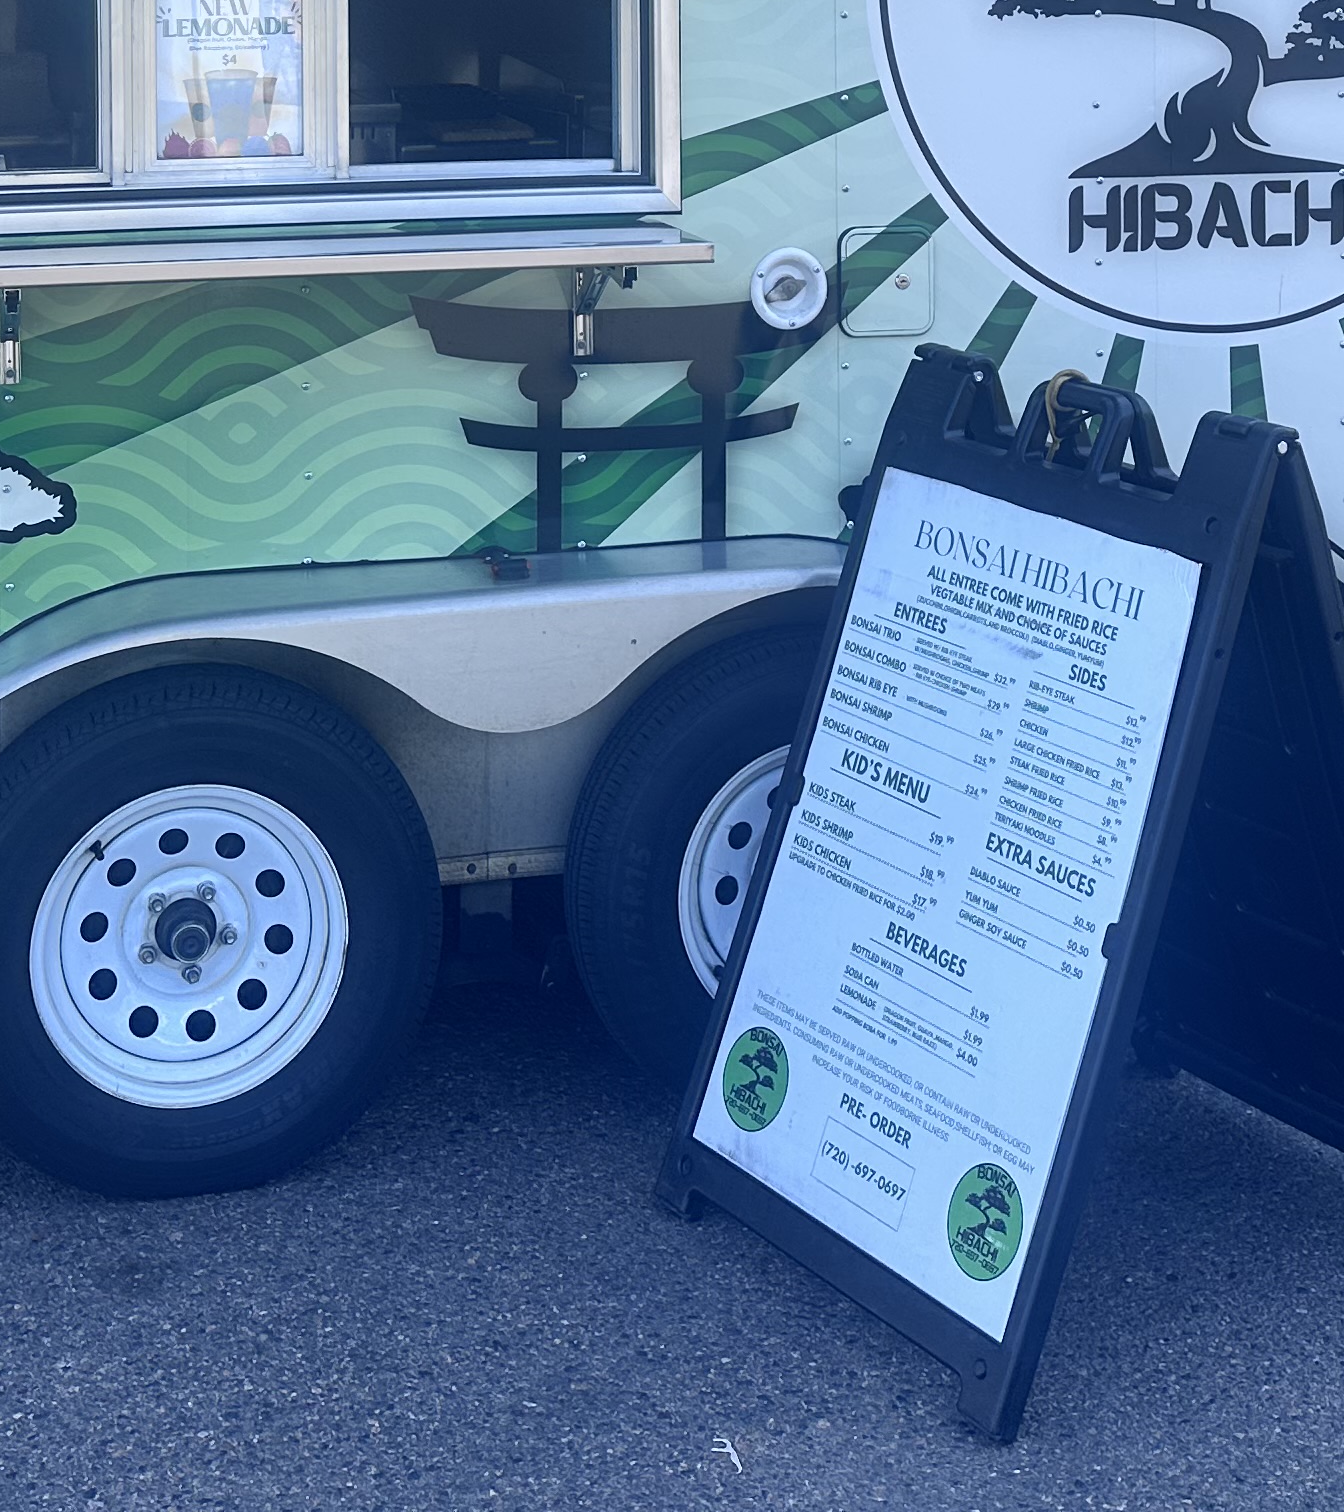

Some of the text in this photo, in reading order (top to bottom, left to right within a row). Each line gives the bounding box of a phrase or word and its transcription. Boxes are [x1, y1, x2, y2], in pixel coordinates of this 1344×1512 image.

[162, 16, 296, 38] LEMONADE
[221, 53, 237, 67] $4
[913, 517, 1146, 622] BONSAI HIBACHI
[892, 600, 949, 635] ENTREES
[926, 563, 1119, 643] ALL ENTREE COME WITH FRIED RICE
[928, 582, 1109, 657] VEGTABLE MIX AND CHOICE OF SAUCES
[849, 613, 882, 635] BONSAI
[881, 625, 903, 643] TRIO
[843, 638, 875, 660] BONSAI
[874, 651, 908, 673] COMBO
[835, 663, 869, 686] BONSAI
[867, 676, 882, 691] RIB
[881, 682, 899, 698] EYE
[1067, 662, 1108, 692] SIDES
[829, 687, 862, 710] BONSAI
[860, 700, 893, 723] SHRIMP
[1053, 688, 1076, 705] STEAK
[821, 715, 854, 738] BONSAI
[852, 728, 890, 754] CHICKEN
[1018, 717, 1049, 737] CHICKEN
[1008, 754, 1031, 771] STEAK
[1030, 763, 1050, 779] FRIED
[1049, 771, 1066, 786] RICE
[1013, 736, 1036, 753] LARGE
[1035, 745, 1066, 766] CHICKEN
[1064, 757, 1085, 773] FRIED
[1084, 765, 1101, 780] RICE
[808, 780, 830, 800] KIDS
[828, 790, 857, 813] STEAK
[881, 765, 932, 805] MENU
[1028, 785, 1048, 802] FRIED
[1047, 793, 1064, 808] RICE
[800, 807, 822, 828] KIDS
[820, 817, 854, 844] SHRIMP
[993, 810, 1024, 832] TERIYAKI
[1022, 823, 1056, 846] NOODLES
[997, 793, 1028, 815] CHICKEN
[1027, 806, 1047, 823] FRIED
[1046, 814, 1063, 830] RICE
[792, 831, 815, 853] KIDS
[812, 841, 852, 871] CHICKEN
[984, 831, 1097, 899] EXTRA SAUCES
[787, 850, 916, 923] UPGRADE TO CHICKEN FRIED RICE FOR $2.00
[969, 865, 1097, 935] DIABLO SAUCE $0.50
[963, 889, 1090, 959] YUM YUM $0.50
[884, 920, 968, 979] BEVERAGES
[957, 907, 1084, 981] GINGER SOY SAUCE $0.50
[850, 941, 990, 1025] BOTTLED WATER $1.99
[843, 963, 983, 1049] SODA CAN $1.99
[750, 1027, 786, 1057] BONSAI
[838, 982, 979, 1069] LEMONADE $4.00
[729, 1081, 767, 1116] HIBACHI
[838, 1091, 913, 1149] PRE- ORDER
[819, 1138, 851, 1172] (720)
[976, 1164, 1017, 1198] BONSAI
[955, 1224, 999, 1264] HIBACHI
